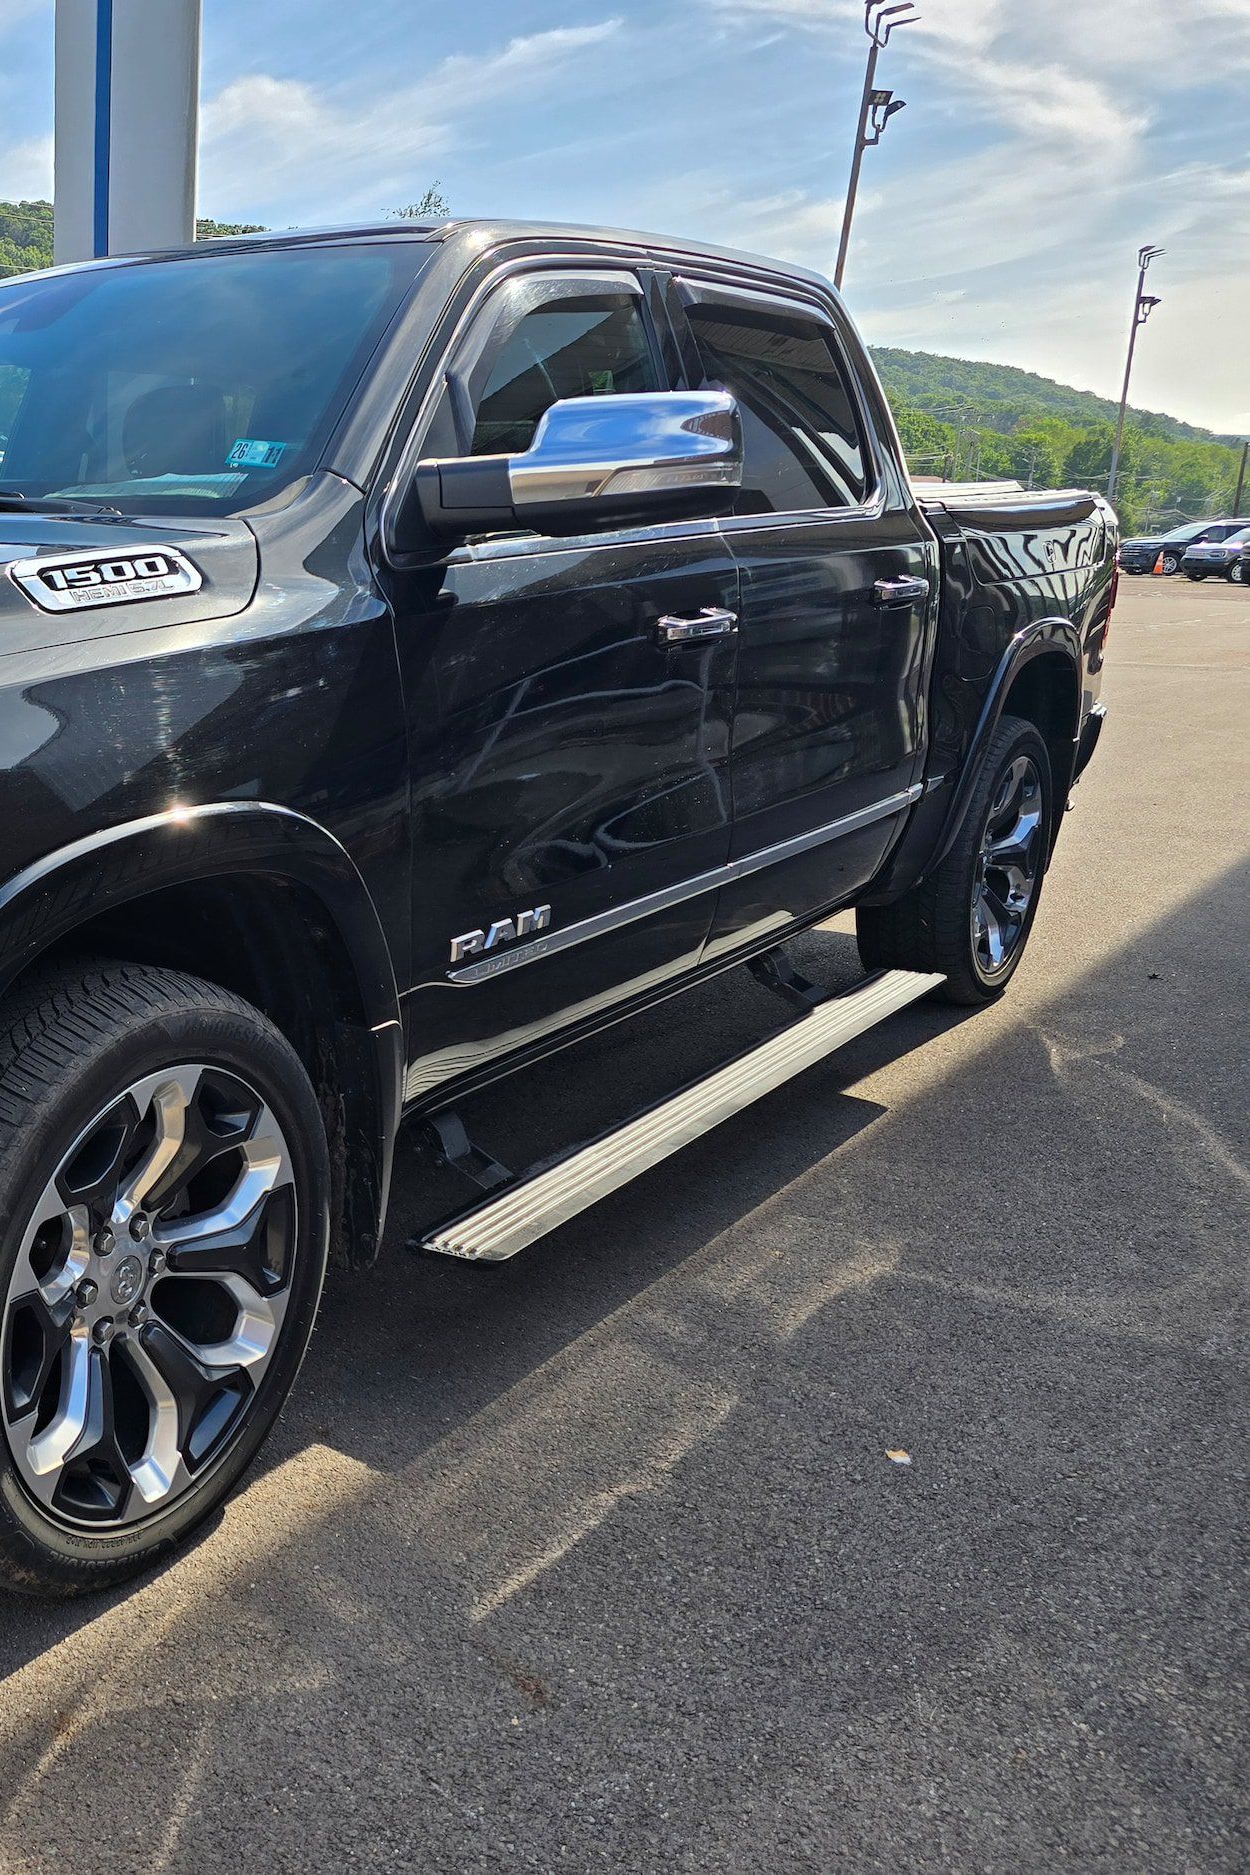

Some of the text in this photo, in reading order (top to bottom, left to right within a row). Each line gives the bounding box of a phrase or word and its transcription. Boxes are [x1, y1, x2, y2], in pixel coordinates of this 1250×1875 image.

[231, 442, 249, 459] 26
[42, 556, 169, 590] 1500
[70, 579, 175, 603] HEMI 5.7L
[450, 904, 552, 963] RAM
